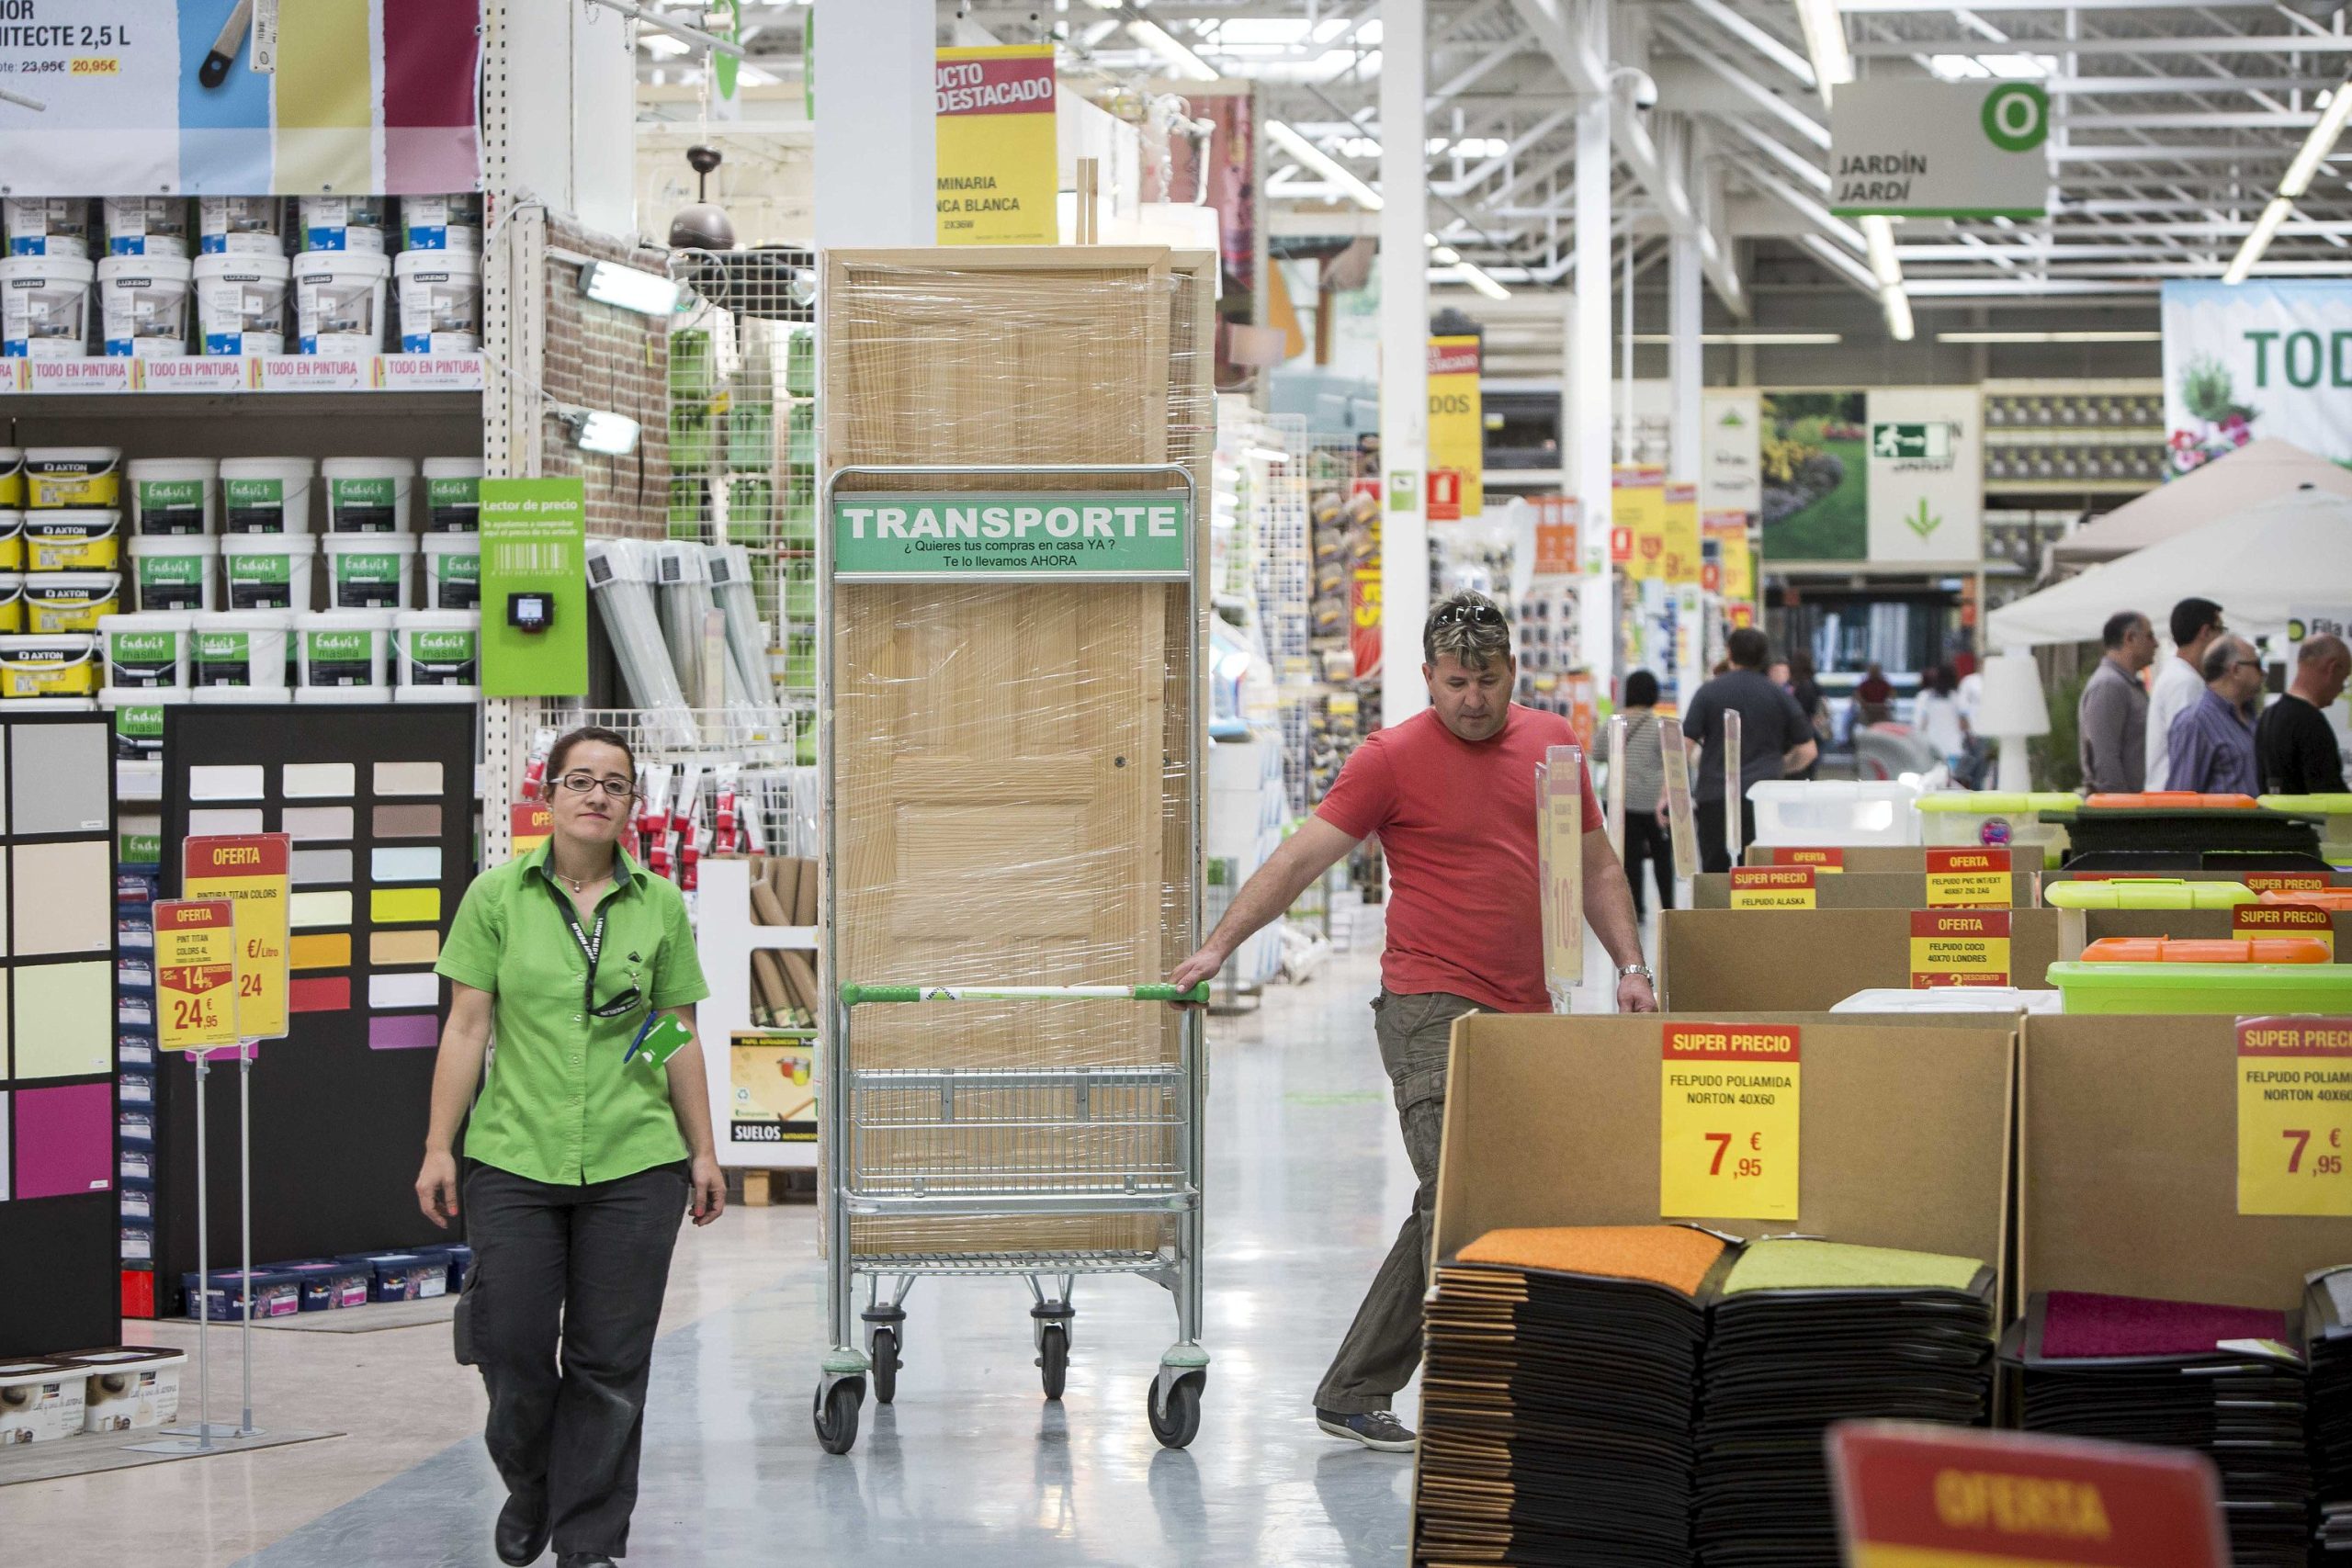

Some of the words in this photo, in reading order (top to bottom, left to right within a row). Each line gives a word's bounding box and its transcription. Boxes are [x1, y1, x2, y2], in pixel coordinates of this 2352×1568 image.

[0, 26, 74, 46] ITECTE
[81, 26, 111, 50] 2,5
[119, 25, 130, 45] L
[22, 61, 65, 73] 23,95€
[73, 60, 117, 72] 20,95€
[936, 77, 1053, 112] DESTACADO
[1995, 92, 2039, 138] O
[1839, 180, 1911, 201] JARDÍ
[965, 197, 1020, 211] BLANCA
[2244, 330, 2352, 388] TOD
[36, 364, 63, 377] TODO
[66, 364, 79, 377] EN
[82, 364, 126, 377] PINTURA
[150, 363, 176, 376] TODO
[179, 363, 192, 376] EN
[196, 363, 239, 376] PINTURA
[267, 362, 294, 375] TODO
[297, 362, 310, 375] EN
[313, 362, 357, 375] PINTURA
[390, 361, 416, 374] TODO
[420, 361, 433, 374] EN
[436, 361, 480, 374] PINTURA
[56, 463, 87, 472] AXTON
[483, 501, 520, 511] Lector
[523, 499, 537, 511] de
[541, 499, 578, 513] precio
[842, 506, 1177, 539] TRANSPORTE
[55, 525, 86, 535] AXTON
[915, 540, 961, 551] Quieres
[965, 541, 981, 551] tus
[985, 542, 1035, 553] compras
[1038, 542, 1053, 550] en
[1057, 542, 1084, 550] casa
[1088, 540, 1105, 550] YA
[1108, 539, 1115, 550] ?
[944, 557, 959, 567] Te
[962, 556, 972, 567] lo
[976, 556, 1027, 566] llevamos
[1031, 555, 1078, 566] AHORA
[57, 589, 89, 598] AXTON
[31, 650, 63, 660] AXTON
[122, 649, 164, 660] masilla
[319, 648, 359, 659] masilla
[423, 648, 464, 659] masilla
[213, 847, 260, 865] OFERTA
[1793, 852, 1826, 862] OFERTA
[1950, 856, 1989, 867] OFERTA
[1735, 873, 1768, 884] SUPER
[1770, 873, 1807, 884] PRECIO
[2248, 879, 2282, 889] SUPER
[2284, 879, 2323, 890] PRECIO
[230, 891, 248, 899] TITAN
[250, 889, 277, 898] COLORS
[176, 908, 212, 922] OFERTA
[2241, 910, 2279, 923] SUPER
[2283, 911, 2326, 923] PRECIO
[1939, 919, 1984, 931] OFERTA
[176, 947, 198, 955] COLORS
[1928, 954, 1951, 963] 40X70
[1952, 954, 1986, 963] LONDRES
[1673, 1034, 1726, 1051] SUPER
[1731, 1034, 1791, 1053] PRECIO
[2245, 1030, 2300, 1047] SUPER
[1670, 1075, 1723, 1087] FELPUDO
[1726, 1076, 1792, 1088] POLIAMIDA
[2246, 1071, 2300, 1083] FELPUDO
[1687, 1092, 1735, 1104] NORTON
[1738, 1093, 1775, 1105] 40X60
[2264, 1089, 2313, 1100] NORTON
[2317, 1089, 2352, 1101] 40X60
[735, 1125, 781, 1140] SUELOS
[2329, 1128, 2342, 1148] €
[1750, 1132, 1762, 1150] €
[1936, 1469, 2111, 1540] OFERTA
